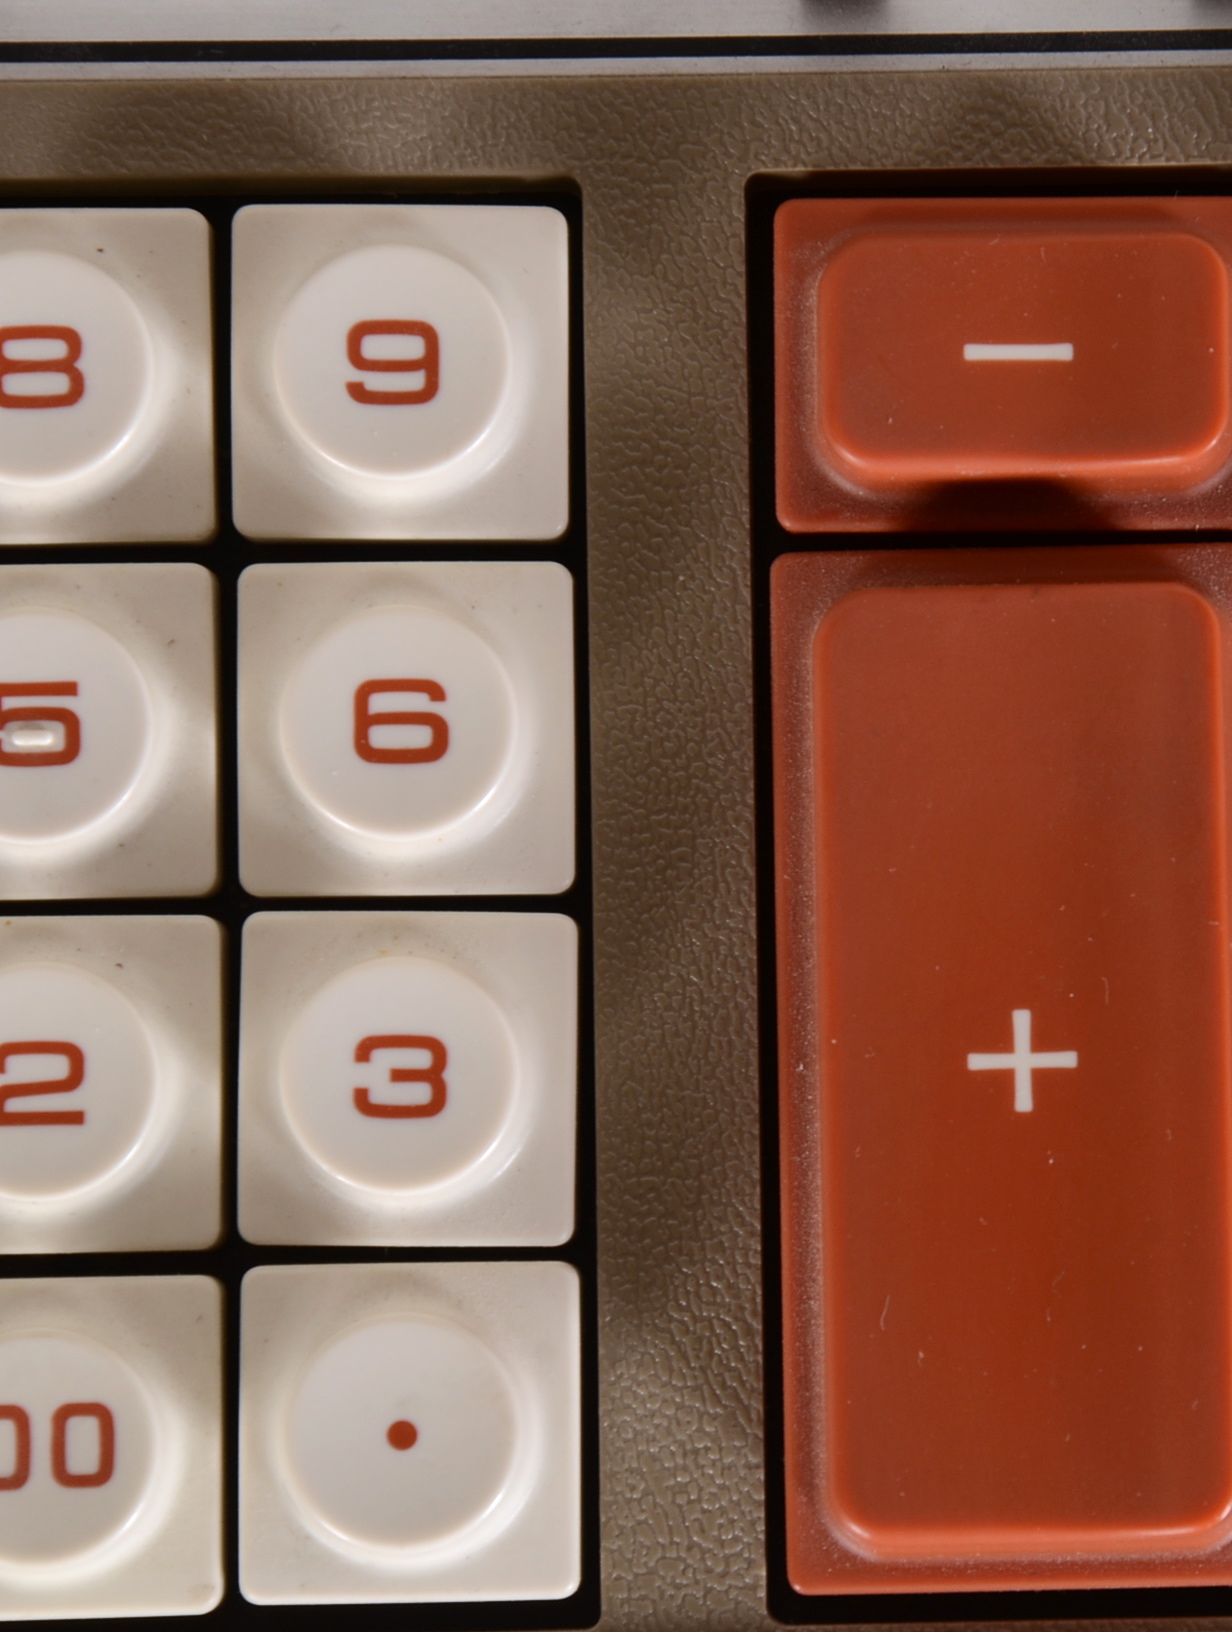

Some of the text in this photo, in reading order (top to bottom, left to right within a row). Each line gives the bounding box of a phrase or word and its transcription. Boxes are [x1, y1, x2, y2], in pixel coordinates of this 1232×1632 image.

[0, 325, 85, 408] 8
[346, 320, 440, 405] 9
[0, 681, 81, 767] 5
[353, 679, 449, 764] 6
[0, 1041, 85, 1126] 2
[353, 1034, 448, 1119] 3
